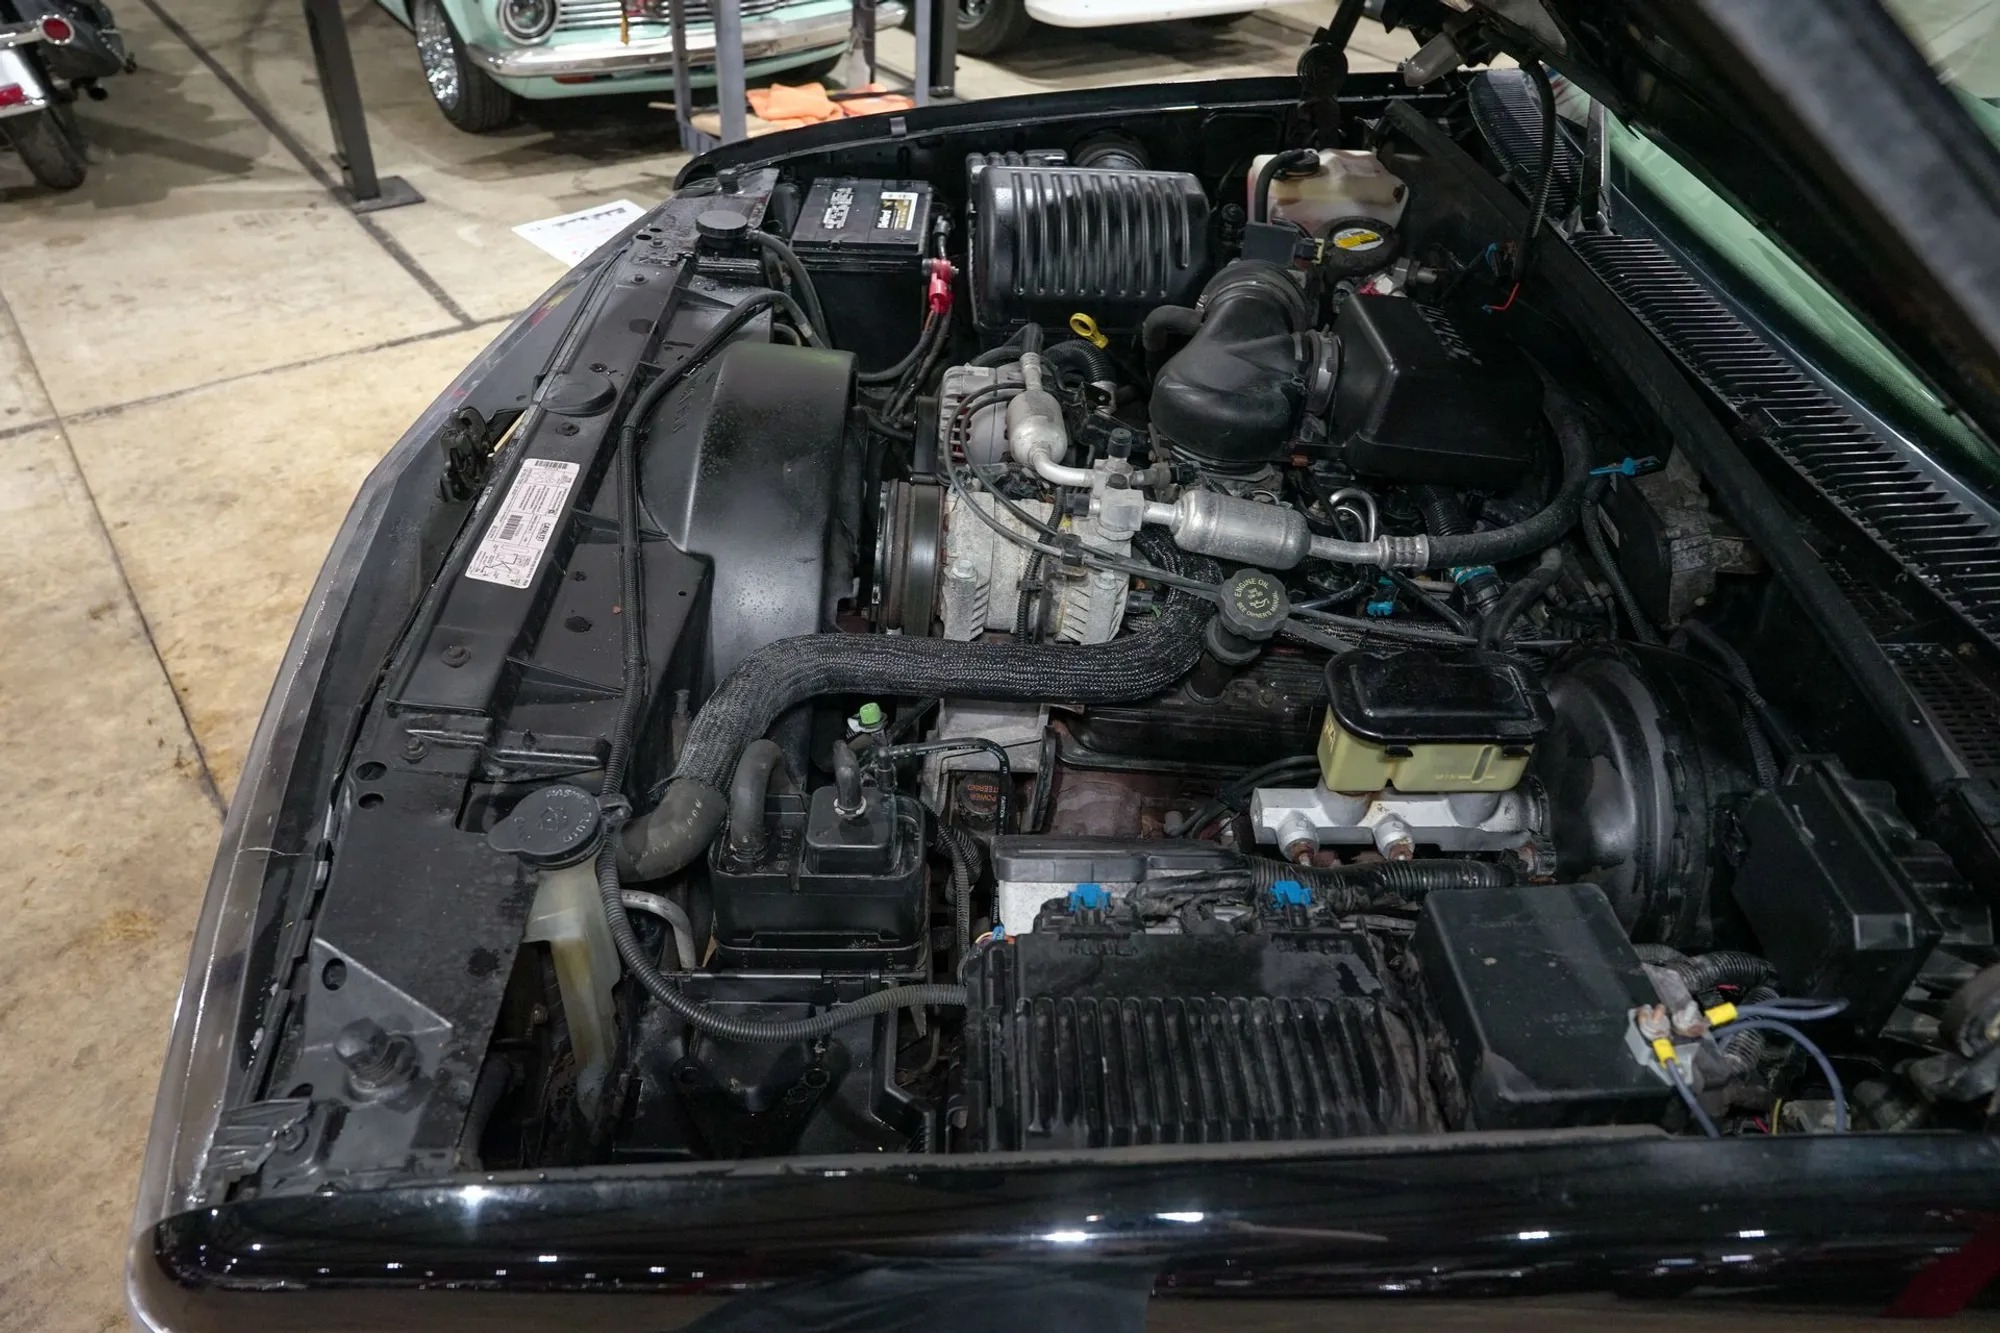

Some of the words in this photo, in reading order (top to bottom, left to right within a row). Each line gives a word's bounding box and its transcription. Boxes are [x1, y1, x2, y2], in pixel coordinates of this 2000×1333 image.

[538, 522, 550, 541] CATALYST
[1234, 578, 1257, 597] ENGINE
[1258, 579, 1269, 589] OIL
[1237, 602, 1247, 612] SEE
[970, 793, 997, 801] POWER
